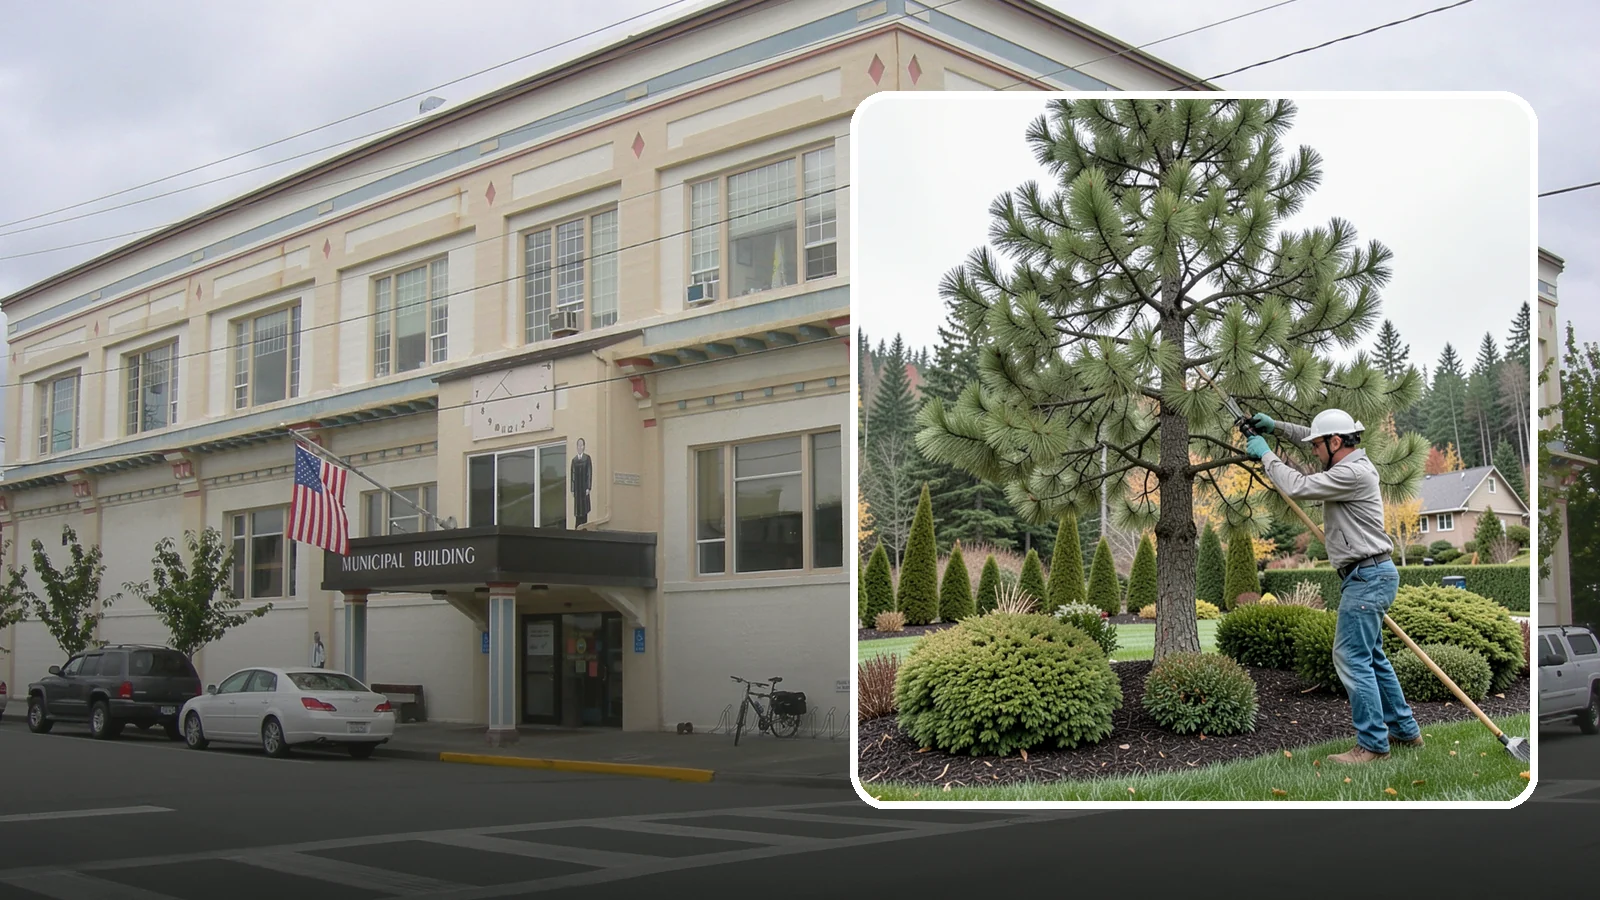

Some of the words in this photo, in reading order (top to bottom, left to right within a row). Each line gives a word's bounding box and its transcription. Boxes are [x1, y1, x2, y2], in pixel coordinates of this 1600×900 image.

[536, 402, 540, 410] 4
[488, 418, 492, 426] 9
[528, 414, 533, 422] 3
[494, 423, 500, 432] 10
[507, 425, 513, 433] 12
[342, 552, 405, 572] MUNICIPAL
[414, 546, 475, 567] BUILDING
